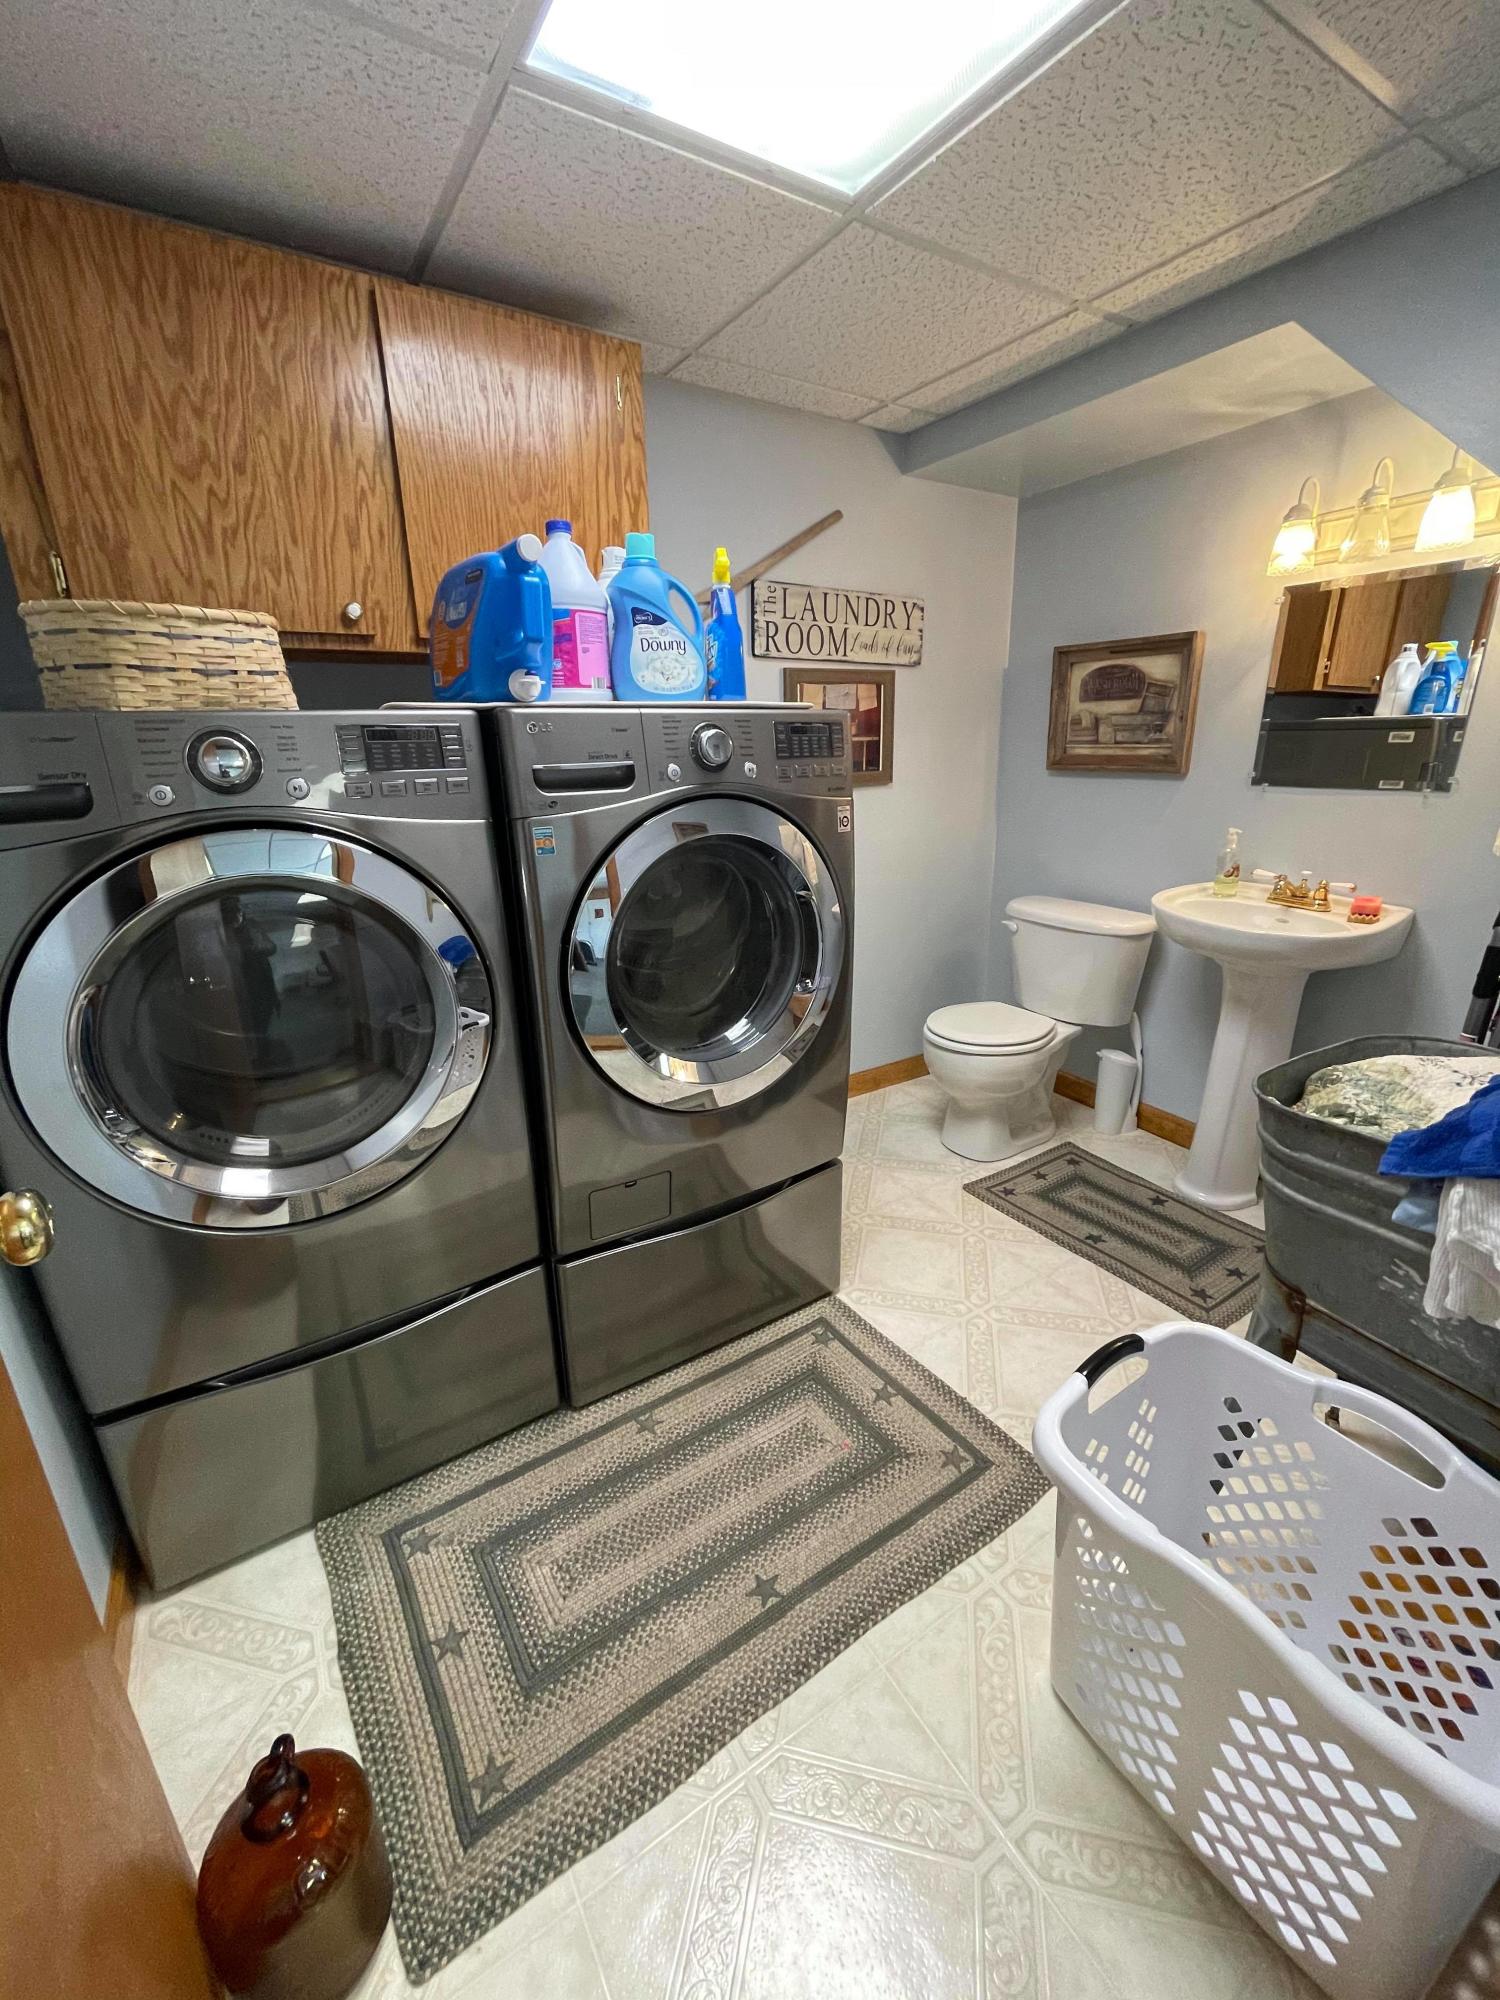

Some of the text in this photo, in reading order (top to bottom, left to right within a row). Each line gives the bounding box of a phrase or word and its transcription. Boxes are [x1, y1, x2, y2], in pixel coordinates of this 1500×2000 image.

[764, 585, 777, 615] The
[781, 587, 918, 631] LAUNDRY
[640, 637, 686, 655] Downy
[764, 620, 850, 657] ROOM
